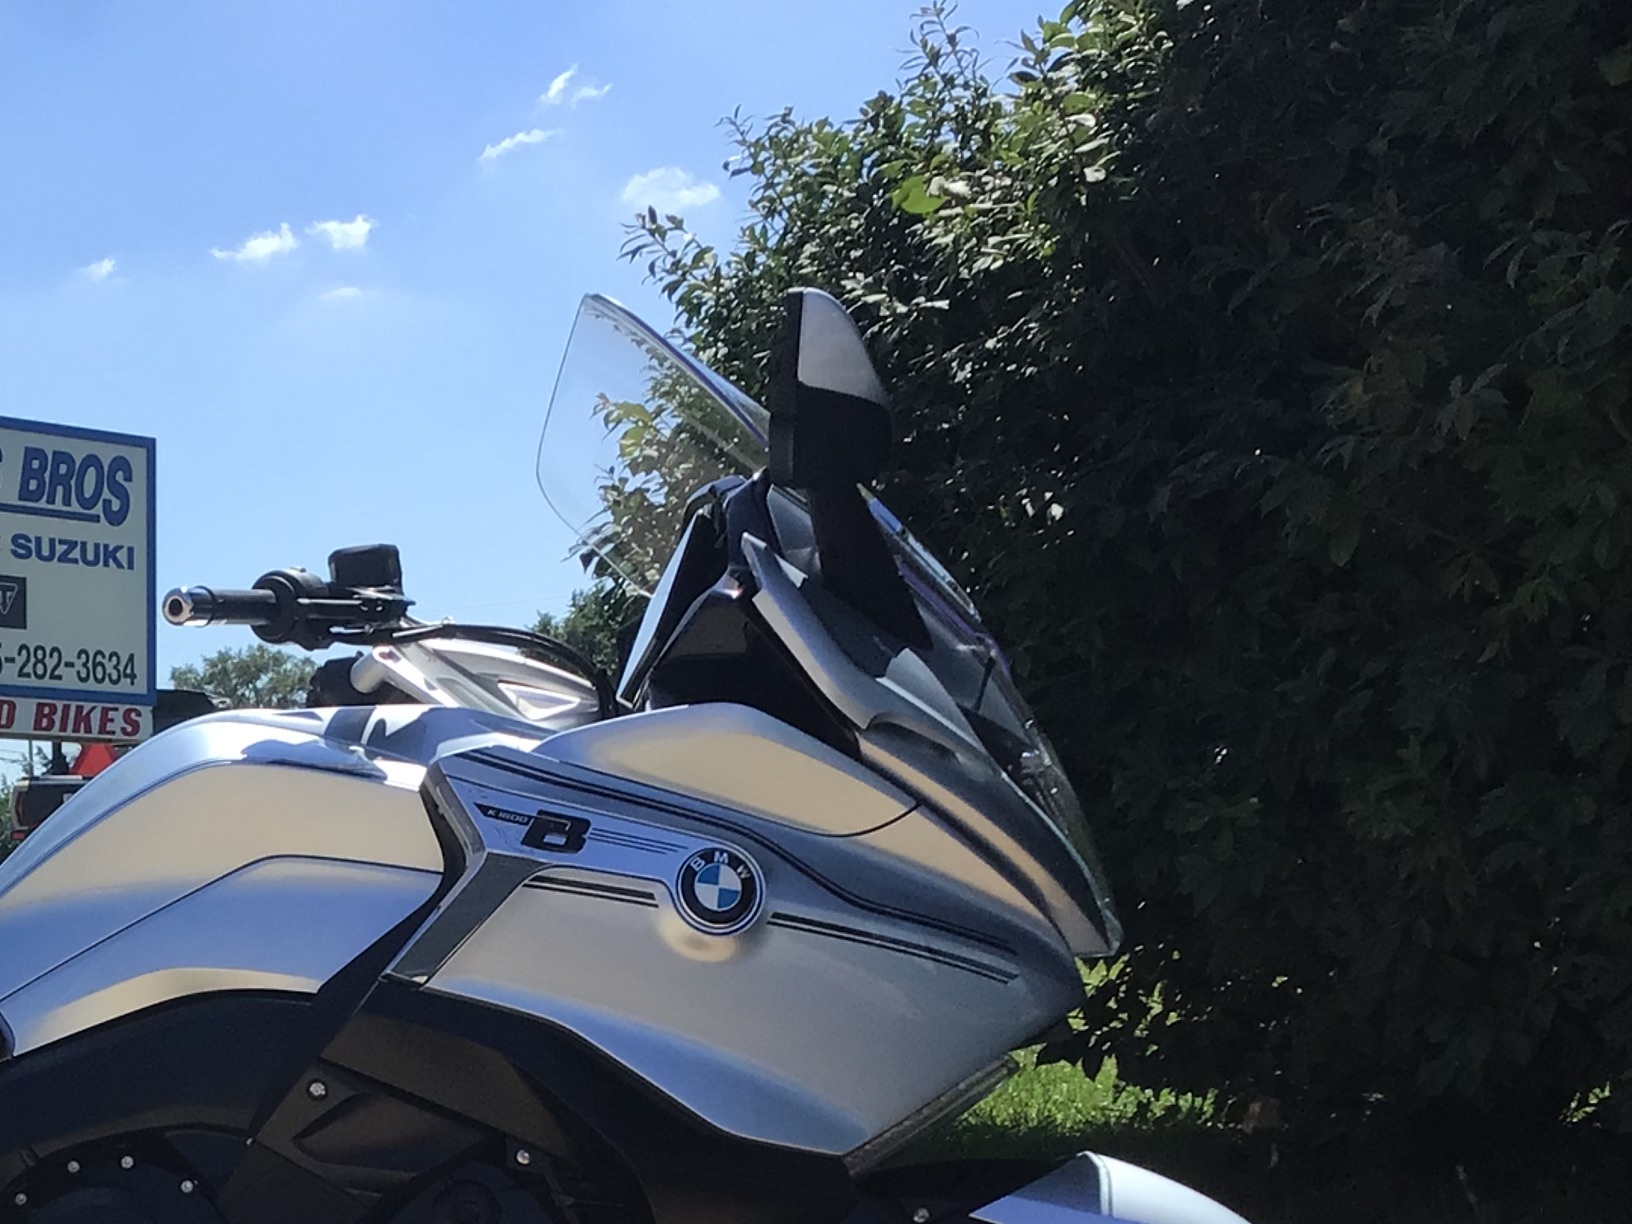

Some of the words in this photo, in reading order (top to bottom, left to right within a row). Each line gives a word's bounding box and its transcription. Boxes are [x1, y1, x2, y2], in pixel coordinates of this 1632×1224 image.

[18, 445, 133, 527] BROS
[9, 532, 135, 571] SUZUKI
[32, 701, 143, 738] BIKES
[689, 850, 752, 880] BMW
